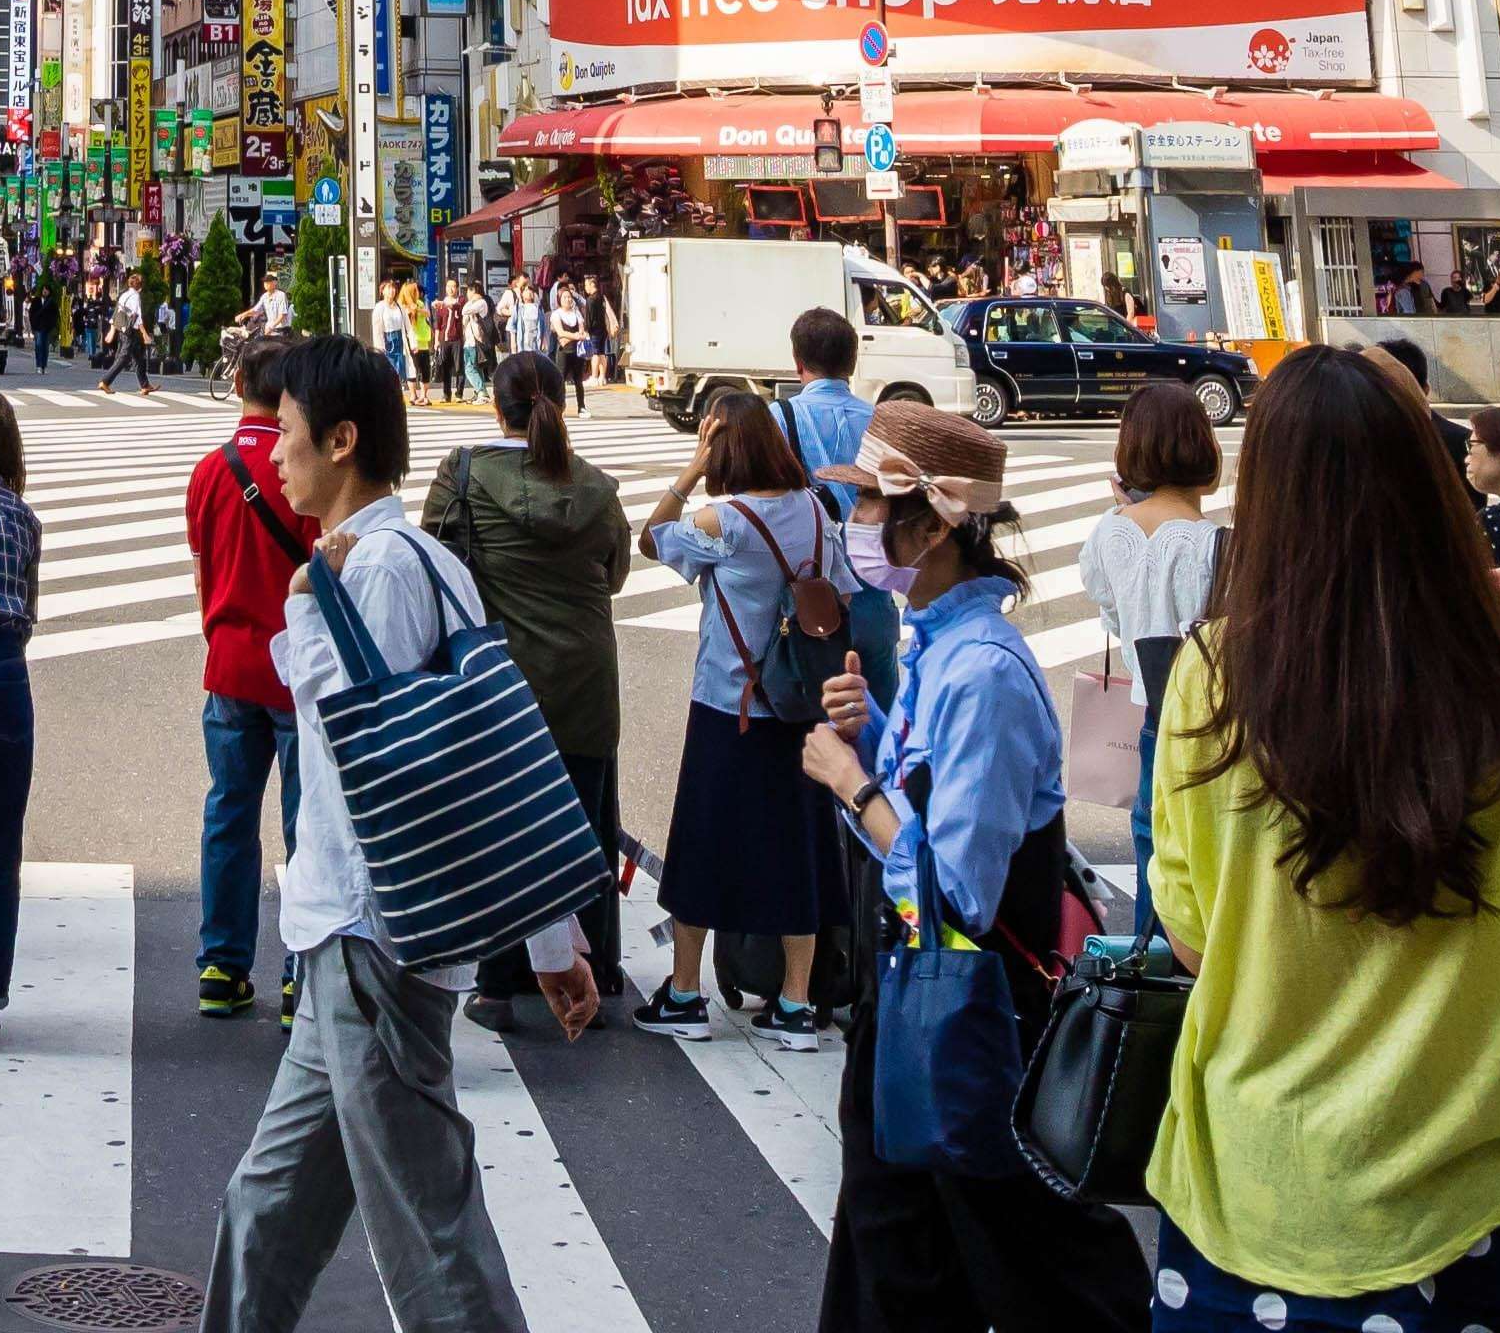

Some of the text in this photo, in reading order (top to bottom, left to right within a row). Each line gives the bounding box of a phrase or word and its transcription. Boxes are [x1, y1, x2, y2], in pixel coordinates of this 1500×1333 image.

[208, 24, 234, 42] B1
[1304, 31, 1344, 46] Japan.
[11, 4, 29, 109] 新宿東宝ビル店
[1302, 46, 1345, 60] Tax-free
[1318, 60, 1346, 74] Shop
[718, 125, 768, 147] Don
[428, 100, 452, 203] カラオケ
[430, 207, 452, 224] B1
